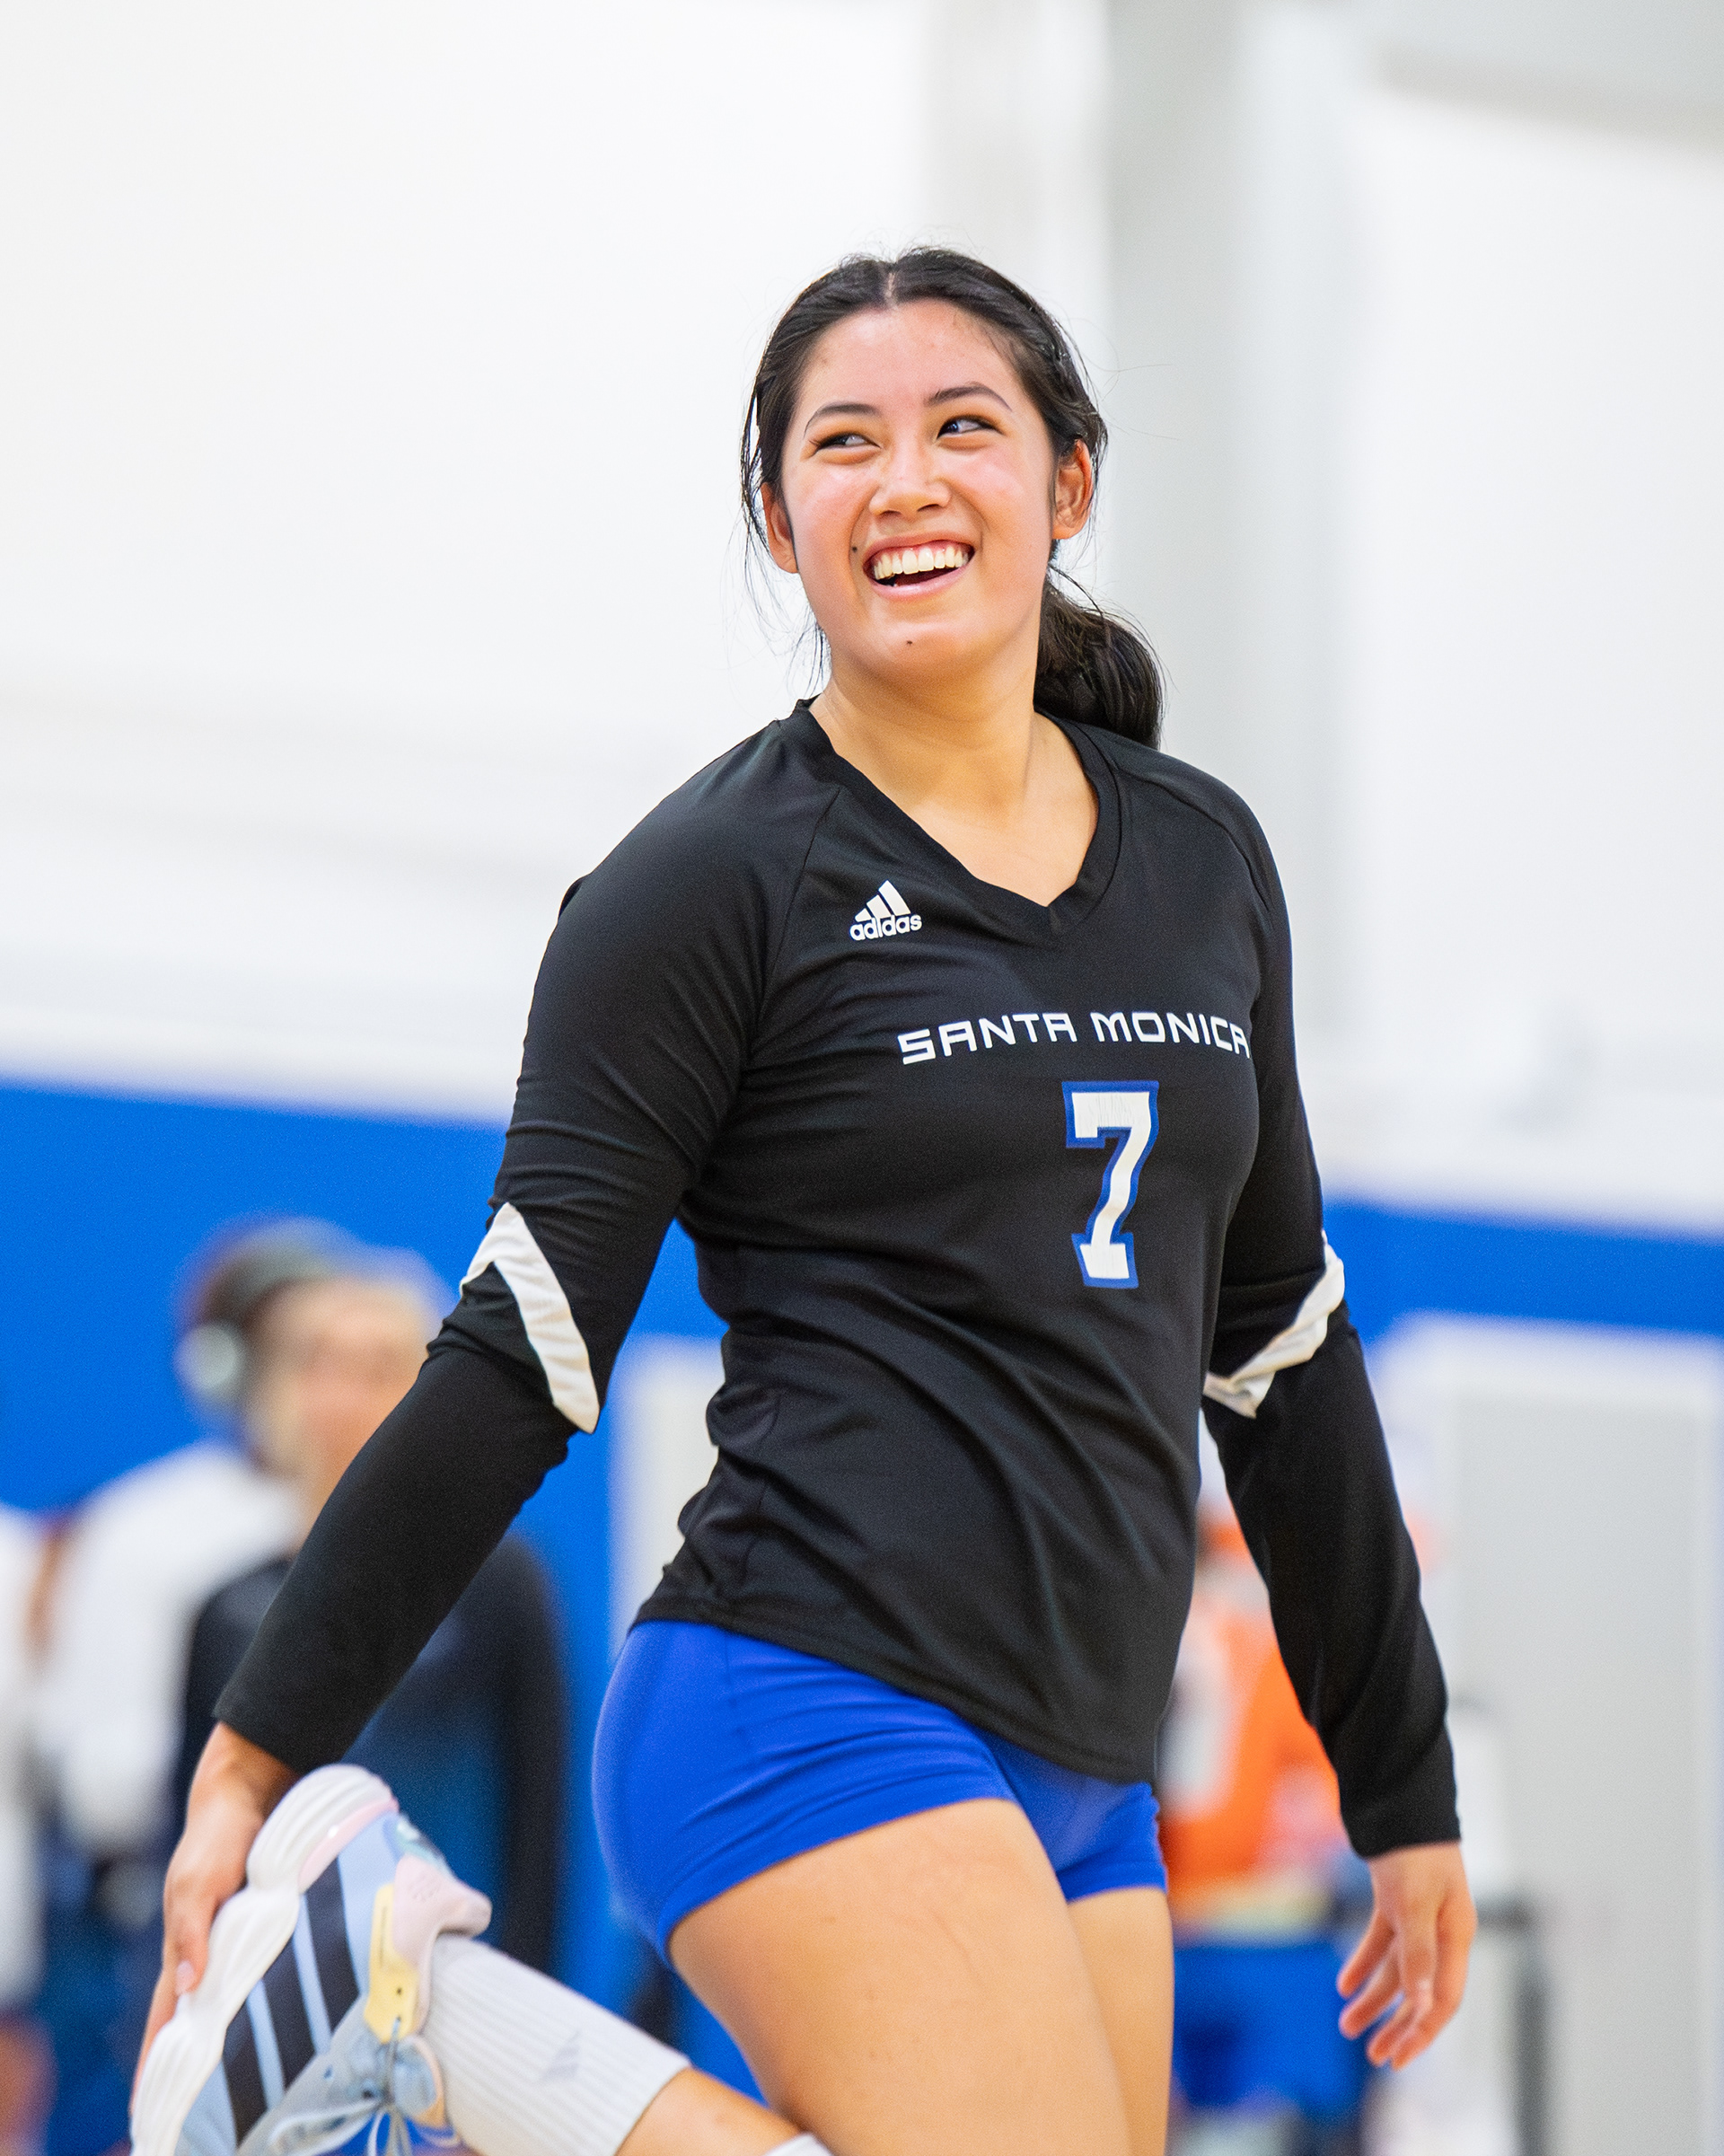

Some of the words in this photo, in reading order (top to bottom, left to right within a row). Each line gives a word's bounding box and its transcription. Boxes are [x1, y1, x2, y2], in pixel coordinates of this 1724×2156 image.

[849, 914, 922, 941] adidas
[897, 1013, 1078, 1065] SANTA
[1089, 1012, 1251, 1059] MONICA
[1062, 1081, 1159, 1289] 7
